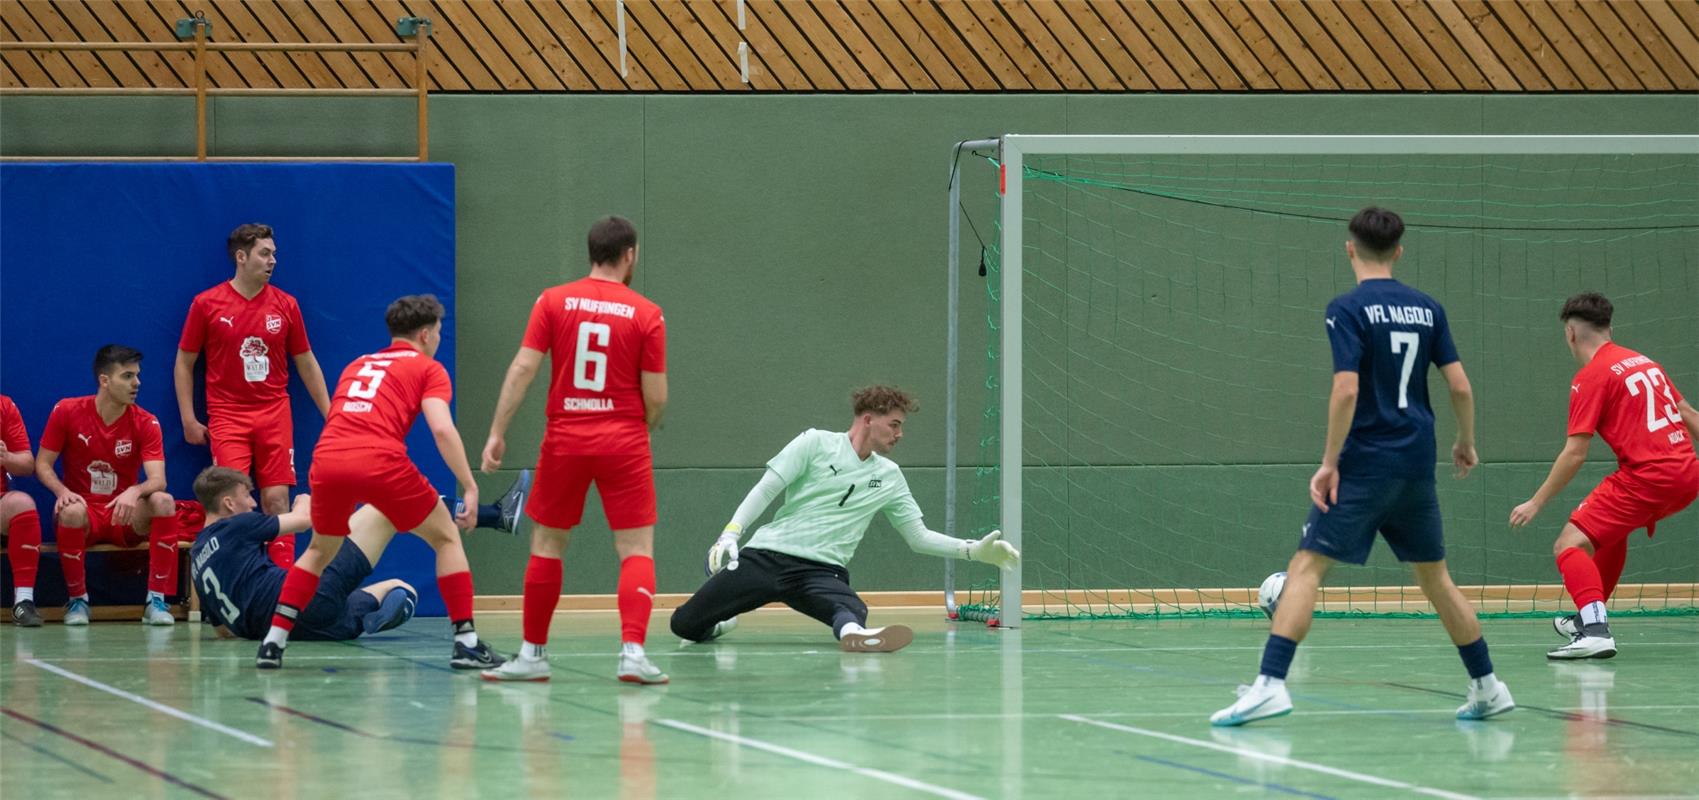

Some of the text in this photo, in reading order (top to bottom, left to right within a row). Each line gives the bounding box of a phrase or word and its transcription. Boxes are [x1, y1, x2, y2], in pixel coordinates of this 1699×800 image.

[565, 297, 635, 319] SV NUFRINGEN
[1364, 304, 1434, 327] VFL NAGOLD
[573, 321, 610, 392] 6
[1390, 331, 1419, 409] 7
[1610, 362, 1625, 376] SV
[347, 360, 392, 399] 5
[563, 397, 614, 411] SCHMOLLA
[1625, 367, 1683, 433] 23
[202, 566, 240, 624] 3
